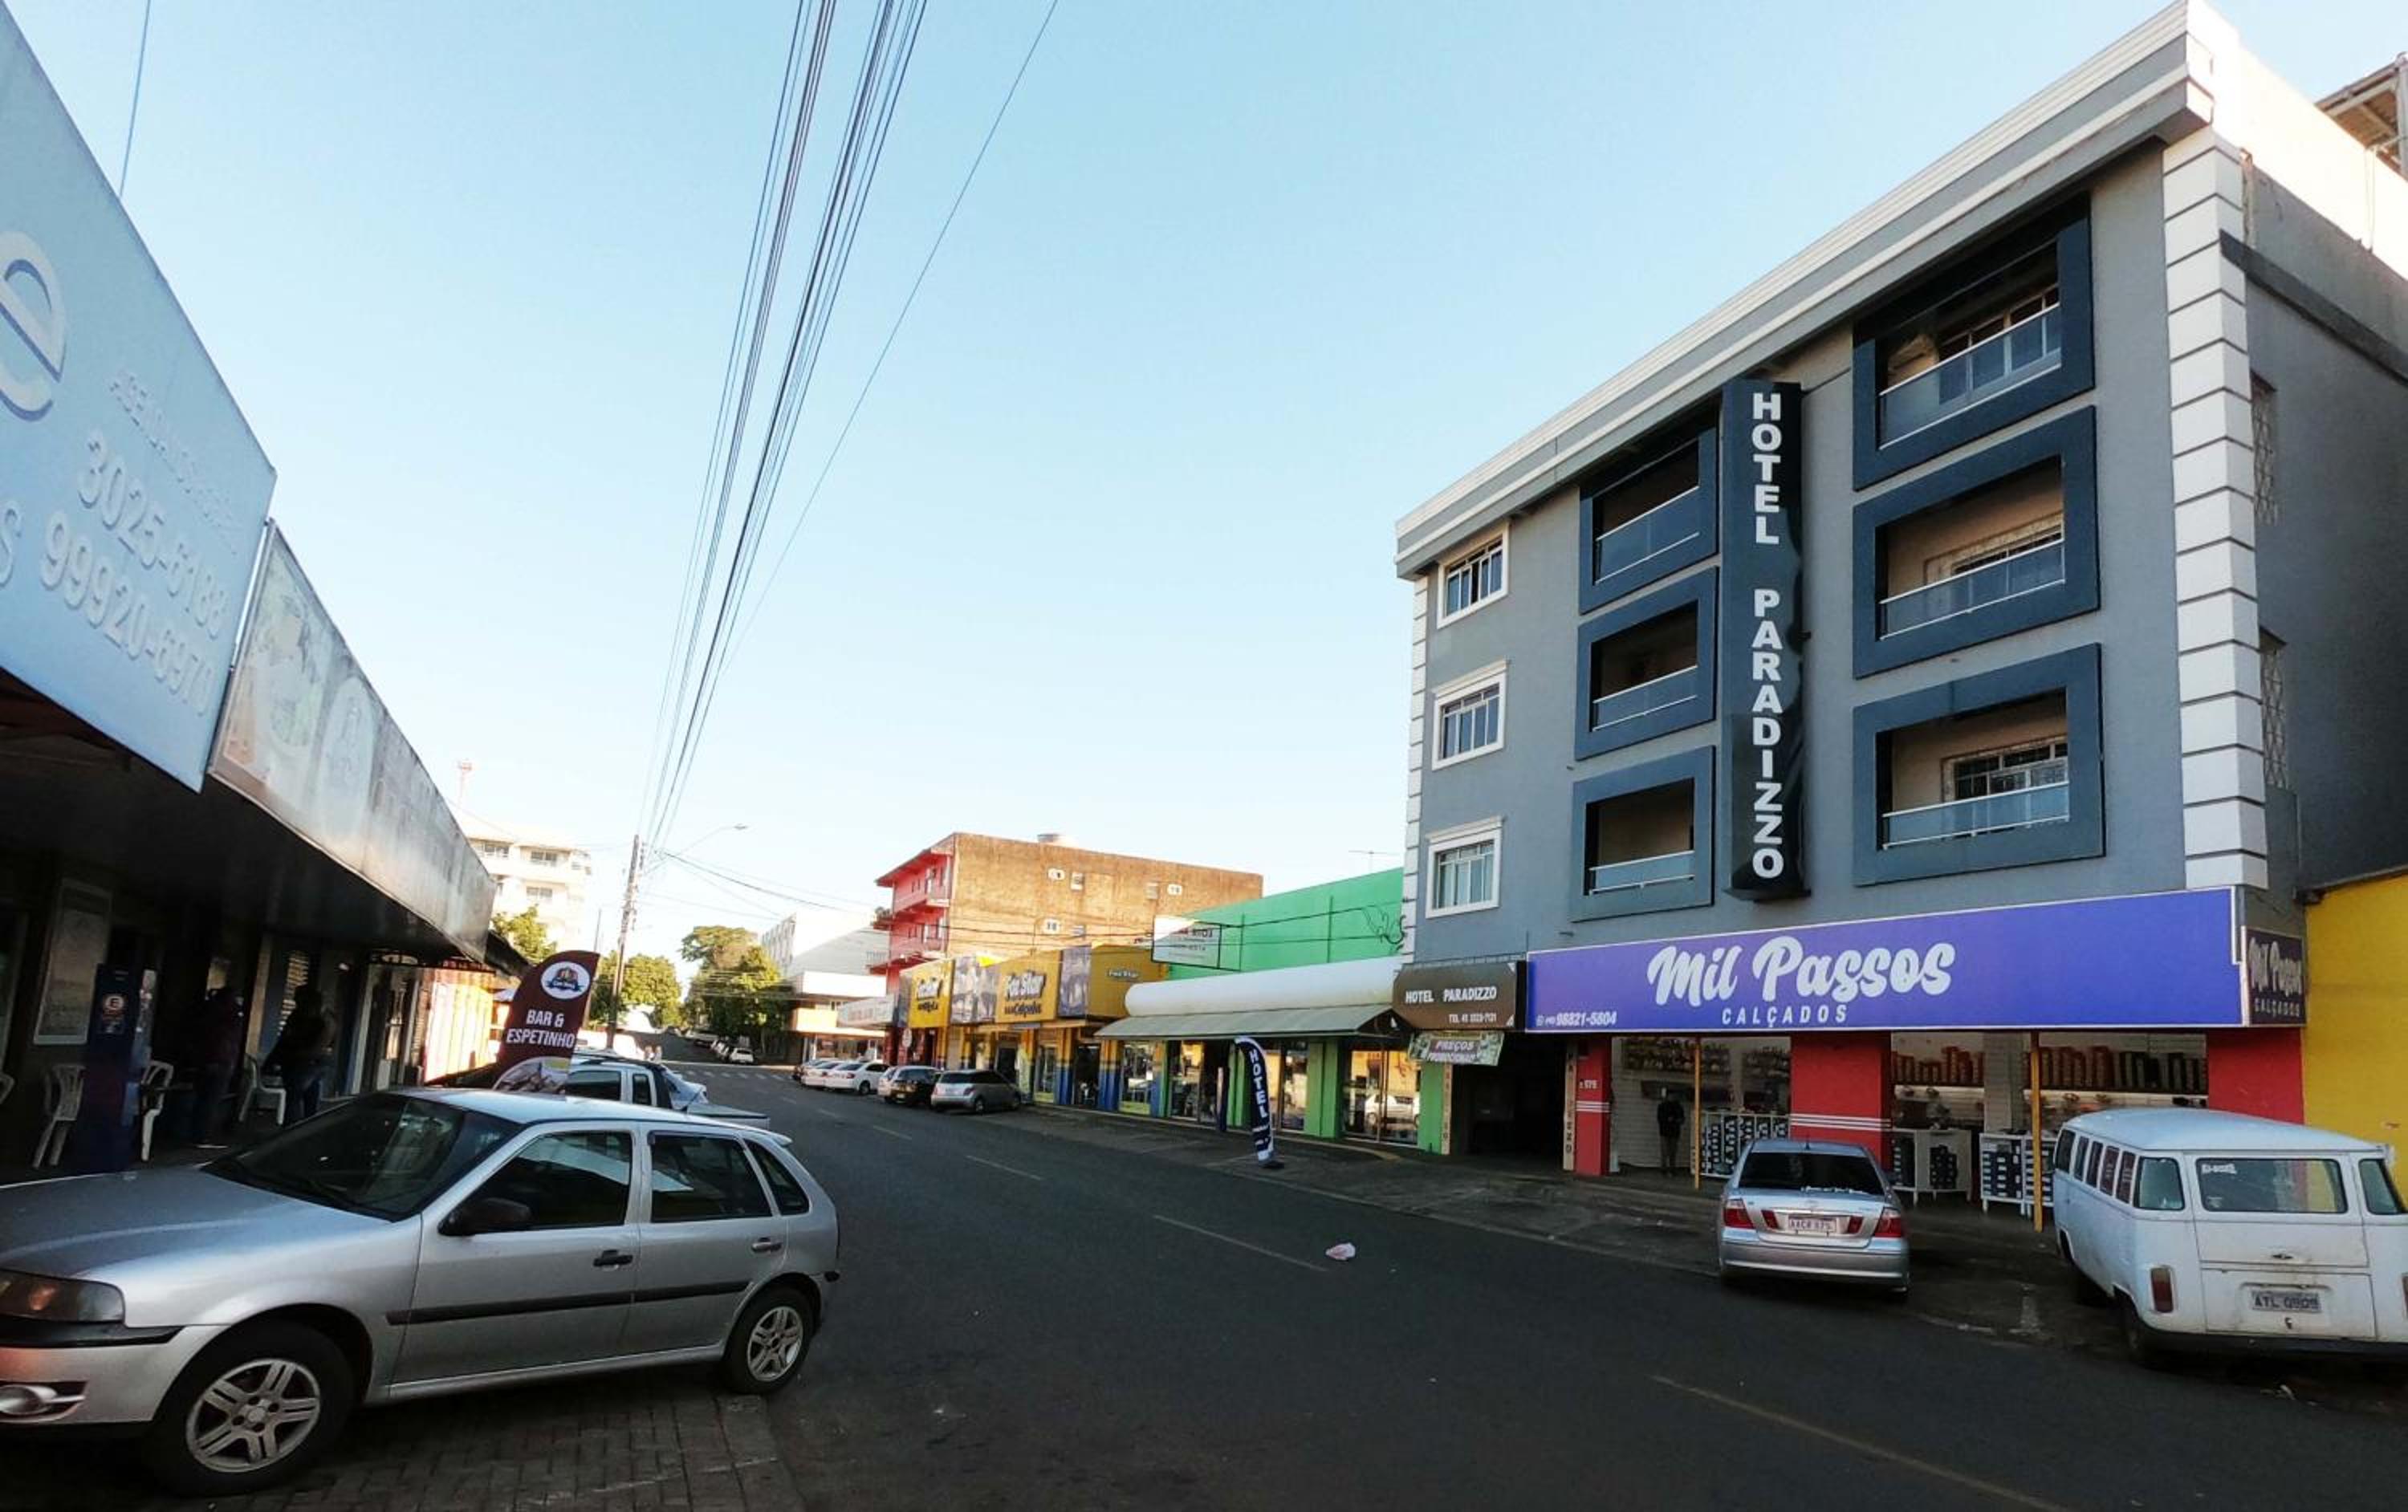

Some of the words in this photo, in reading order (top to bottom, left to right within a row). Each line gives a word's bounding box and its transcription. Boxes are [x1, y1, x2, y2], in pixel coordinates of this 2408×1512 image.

[1751, 392, 1782, 545] HOTEL
[1751, 588, 1784, 879] PARADIZZO
[1405, 990, 1434, 1004] HOTEL
[1443, 986, 1497, 1002] PARADIZZO
[1646, 945, 1743, 1007] Mil
[1752, 936, 1955, 1003] Passos
[506, 1028, 576, 1049] ESPETINHO
[526, 1009, 553, 1026] BAR
[554, 1013, 565, 1027] &
[1722, 1004, 1848, 1028] CALÇADOS
[1249, 1048, 1269, 1119] HOTEL
